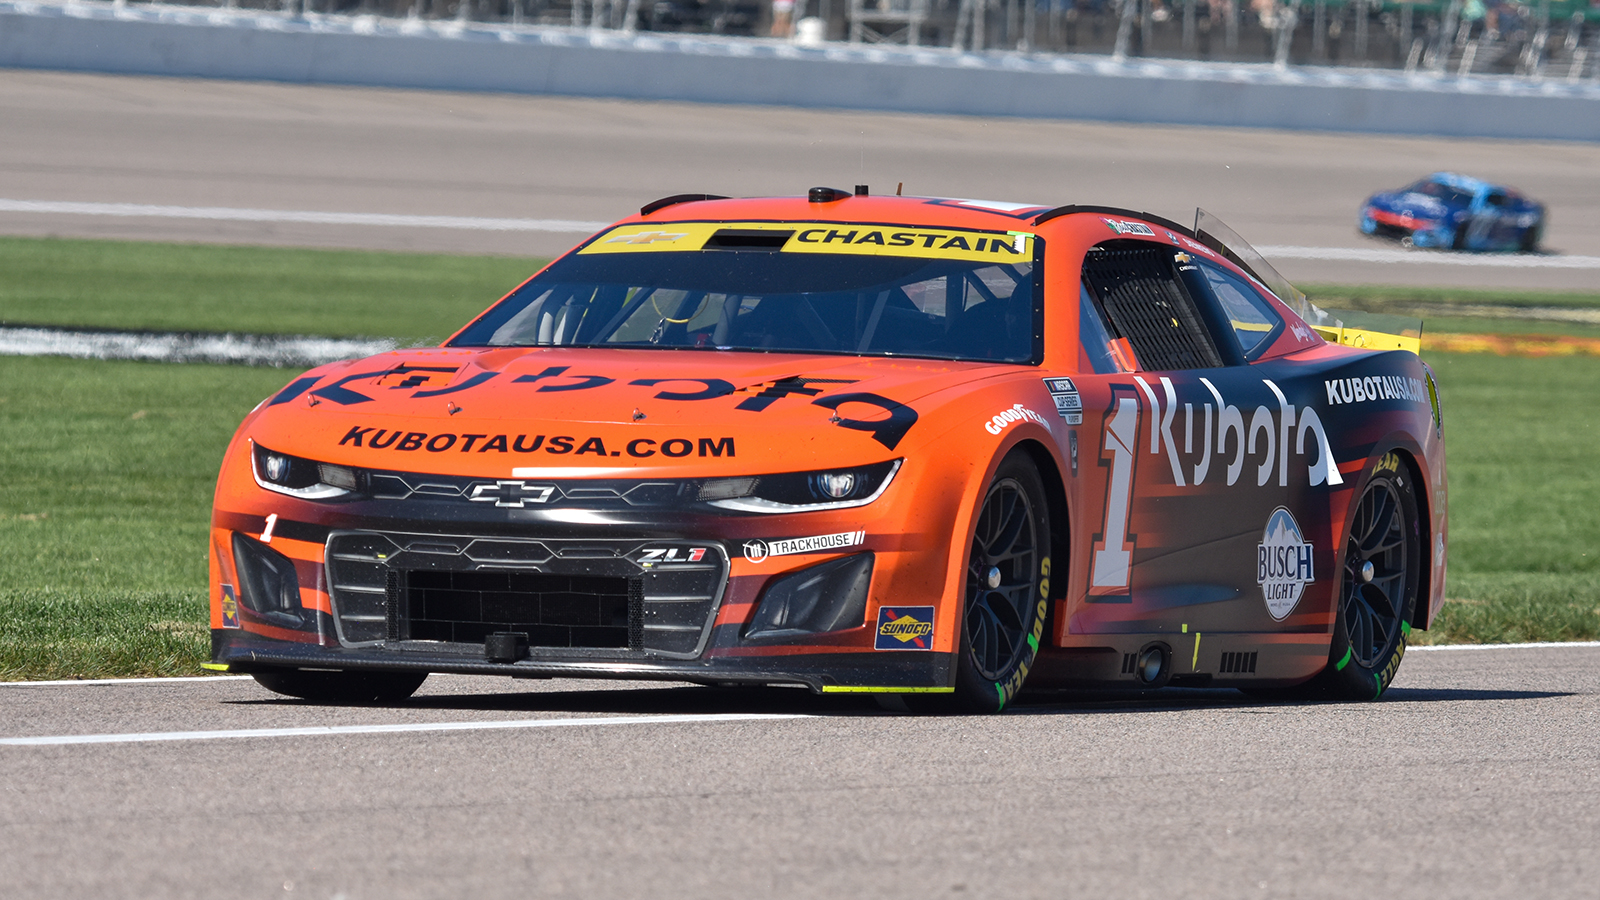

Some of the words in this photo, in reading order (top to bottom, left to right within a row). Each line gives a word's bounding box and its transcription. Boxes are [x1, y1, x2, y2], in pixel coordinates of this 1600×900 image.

[797, 228, 1019, 255] CHASTAIN
[1324, 376, 1426, 405] KUBOTAUSA.COM
[984, 403, 1053, 435] GOODYEAR
[1133, 375, 1344, 487] Kubota
[338, 425, 736, 459] KUBOTAUSA.COM
[1090, 388, 1141, 598] 1
[259, 513, 278, 543] 1
[636, 547, 708, 563] ZL1
[773, 533, 851, 554] TRACKHOUSE
[1258, 545, 1313, 581] BUSCH
[1267, 583, 1297, 600] LIGHT
[880, 623, 930, 636] SUNOCO
